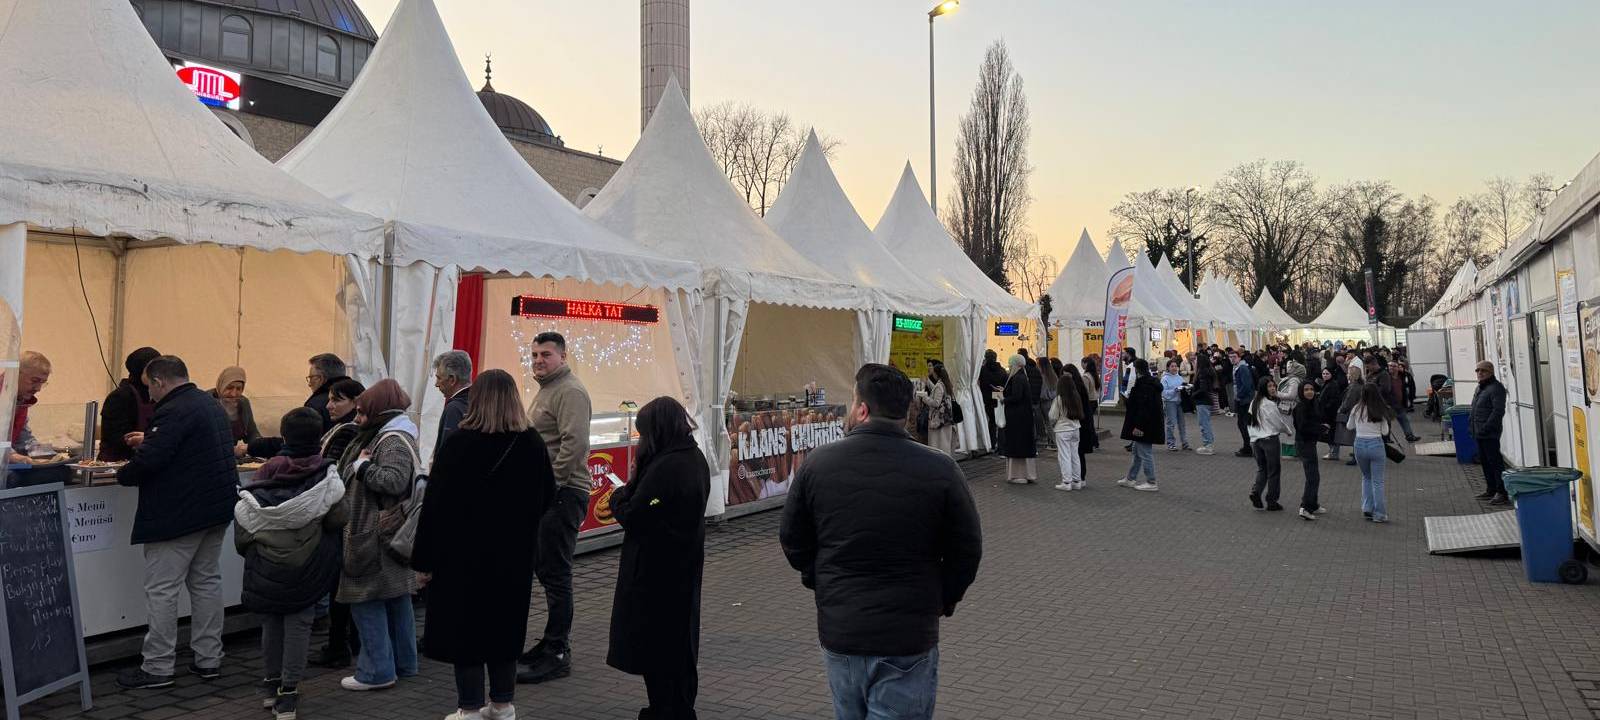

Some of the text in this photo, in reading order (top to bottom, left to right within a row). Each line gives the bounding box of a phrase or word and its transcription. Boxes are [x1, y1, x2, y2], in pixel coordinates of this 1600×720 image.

[566, 302, 624, 318] HALKA TAT
[738, 420, 845, 461] KAANS CHURROS
[77, 500, 105, 512] Menü
[75, 513, 113, 527] Menüsü
